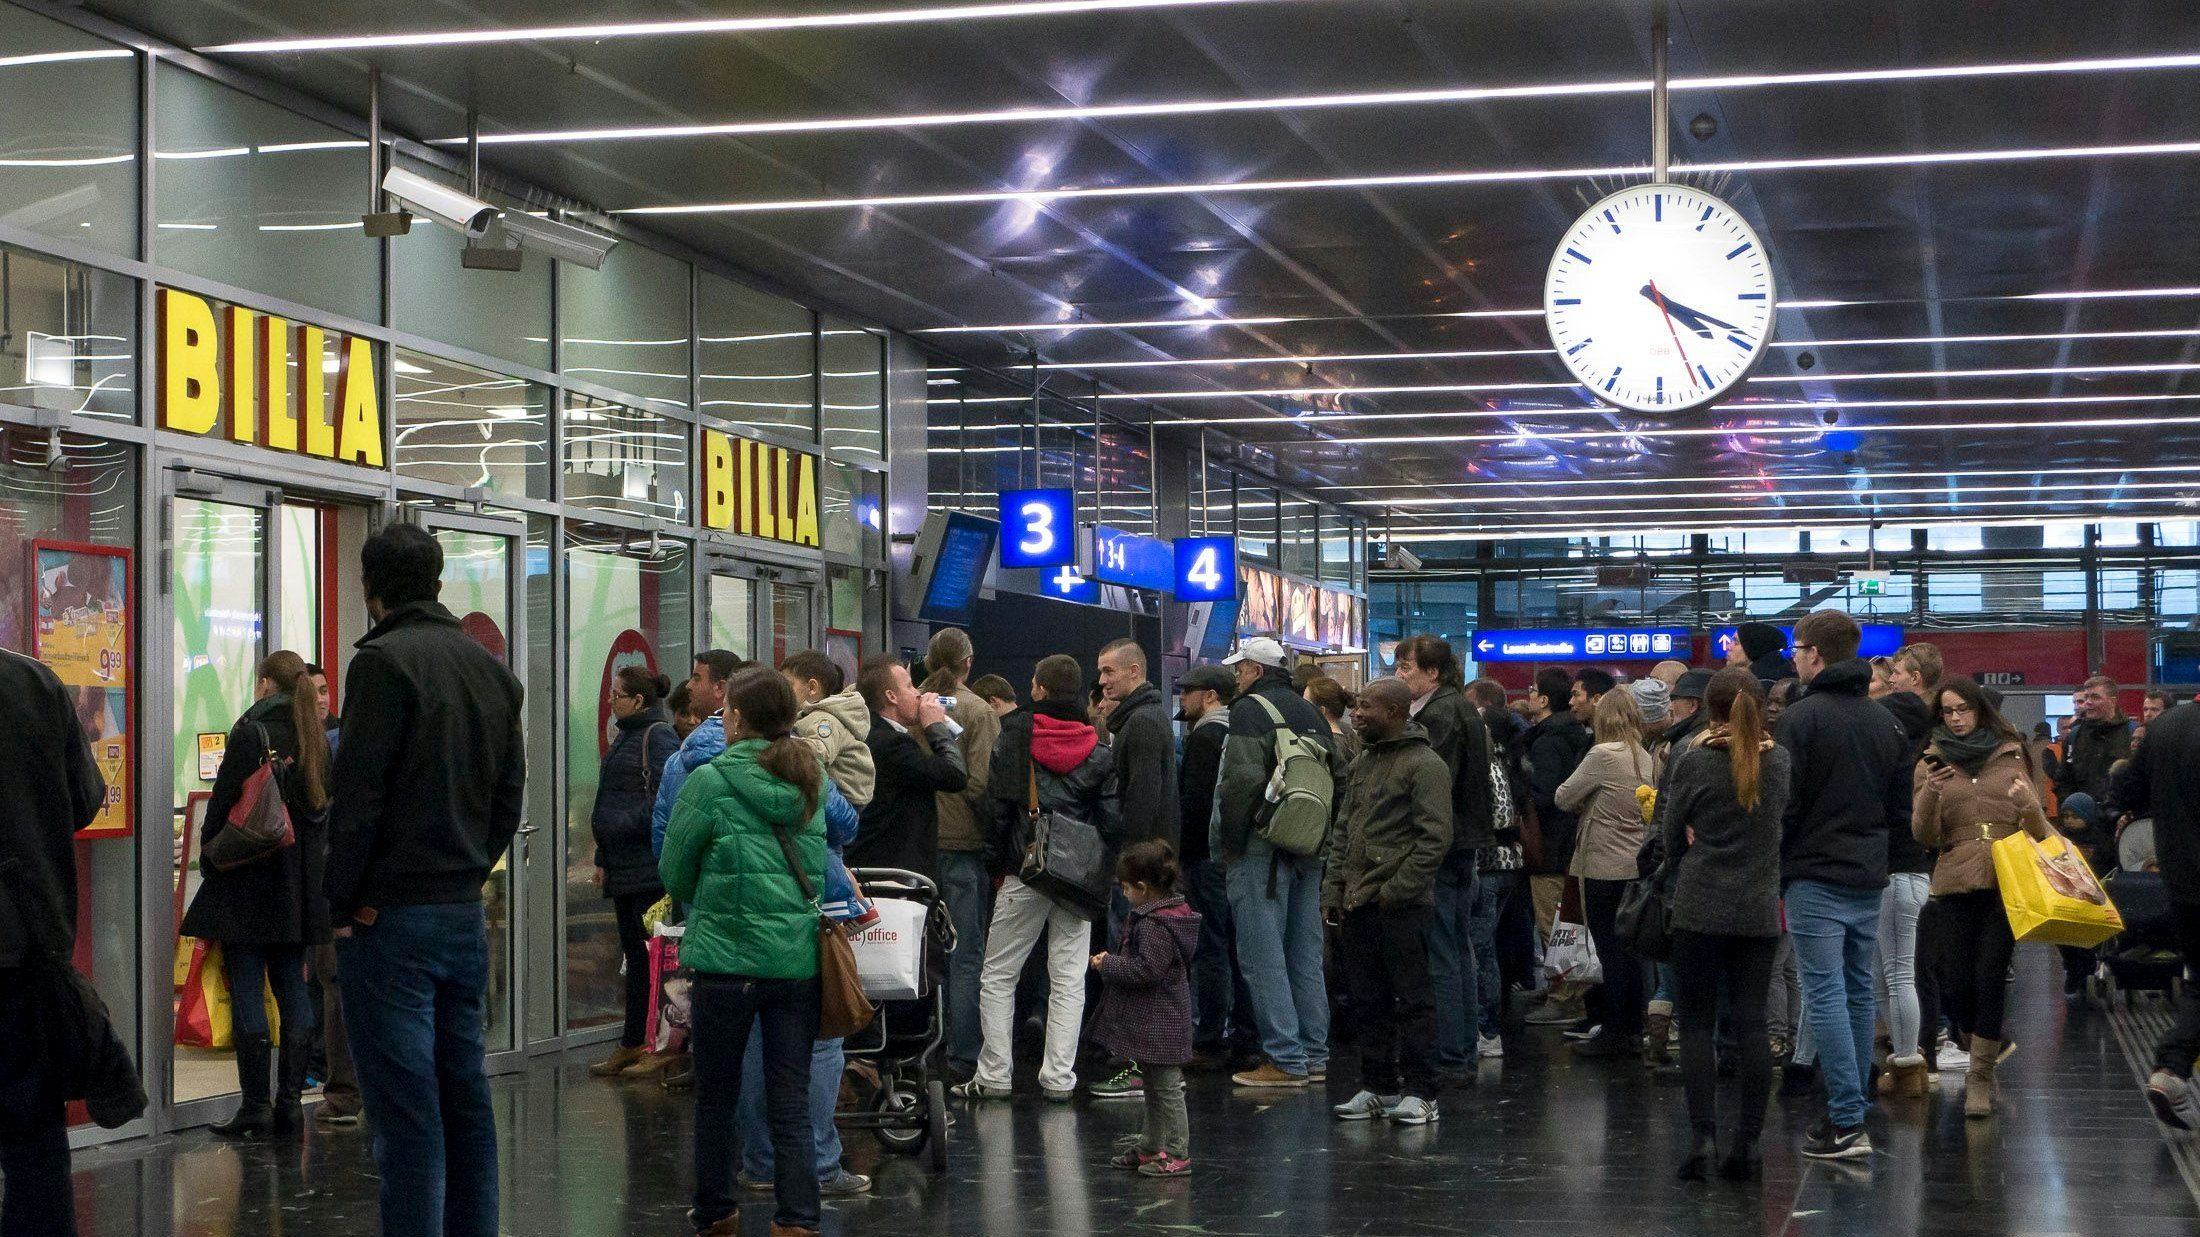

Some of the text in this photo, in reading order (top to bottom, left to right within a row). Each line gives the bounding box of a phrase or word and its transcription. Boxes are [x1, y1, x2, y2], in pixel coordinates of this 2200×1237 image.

[160, 289, 384, 467] BILLA
[701, 429, 819, 546] BILLA
[1020, 503, 1053, 553] 3
[1108, 540, 1125, 570] 3-4
[1187, 548, 1221, 590] 4
